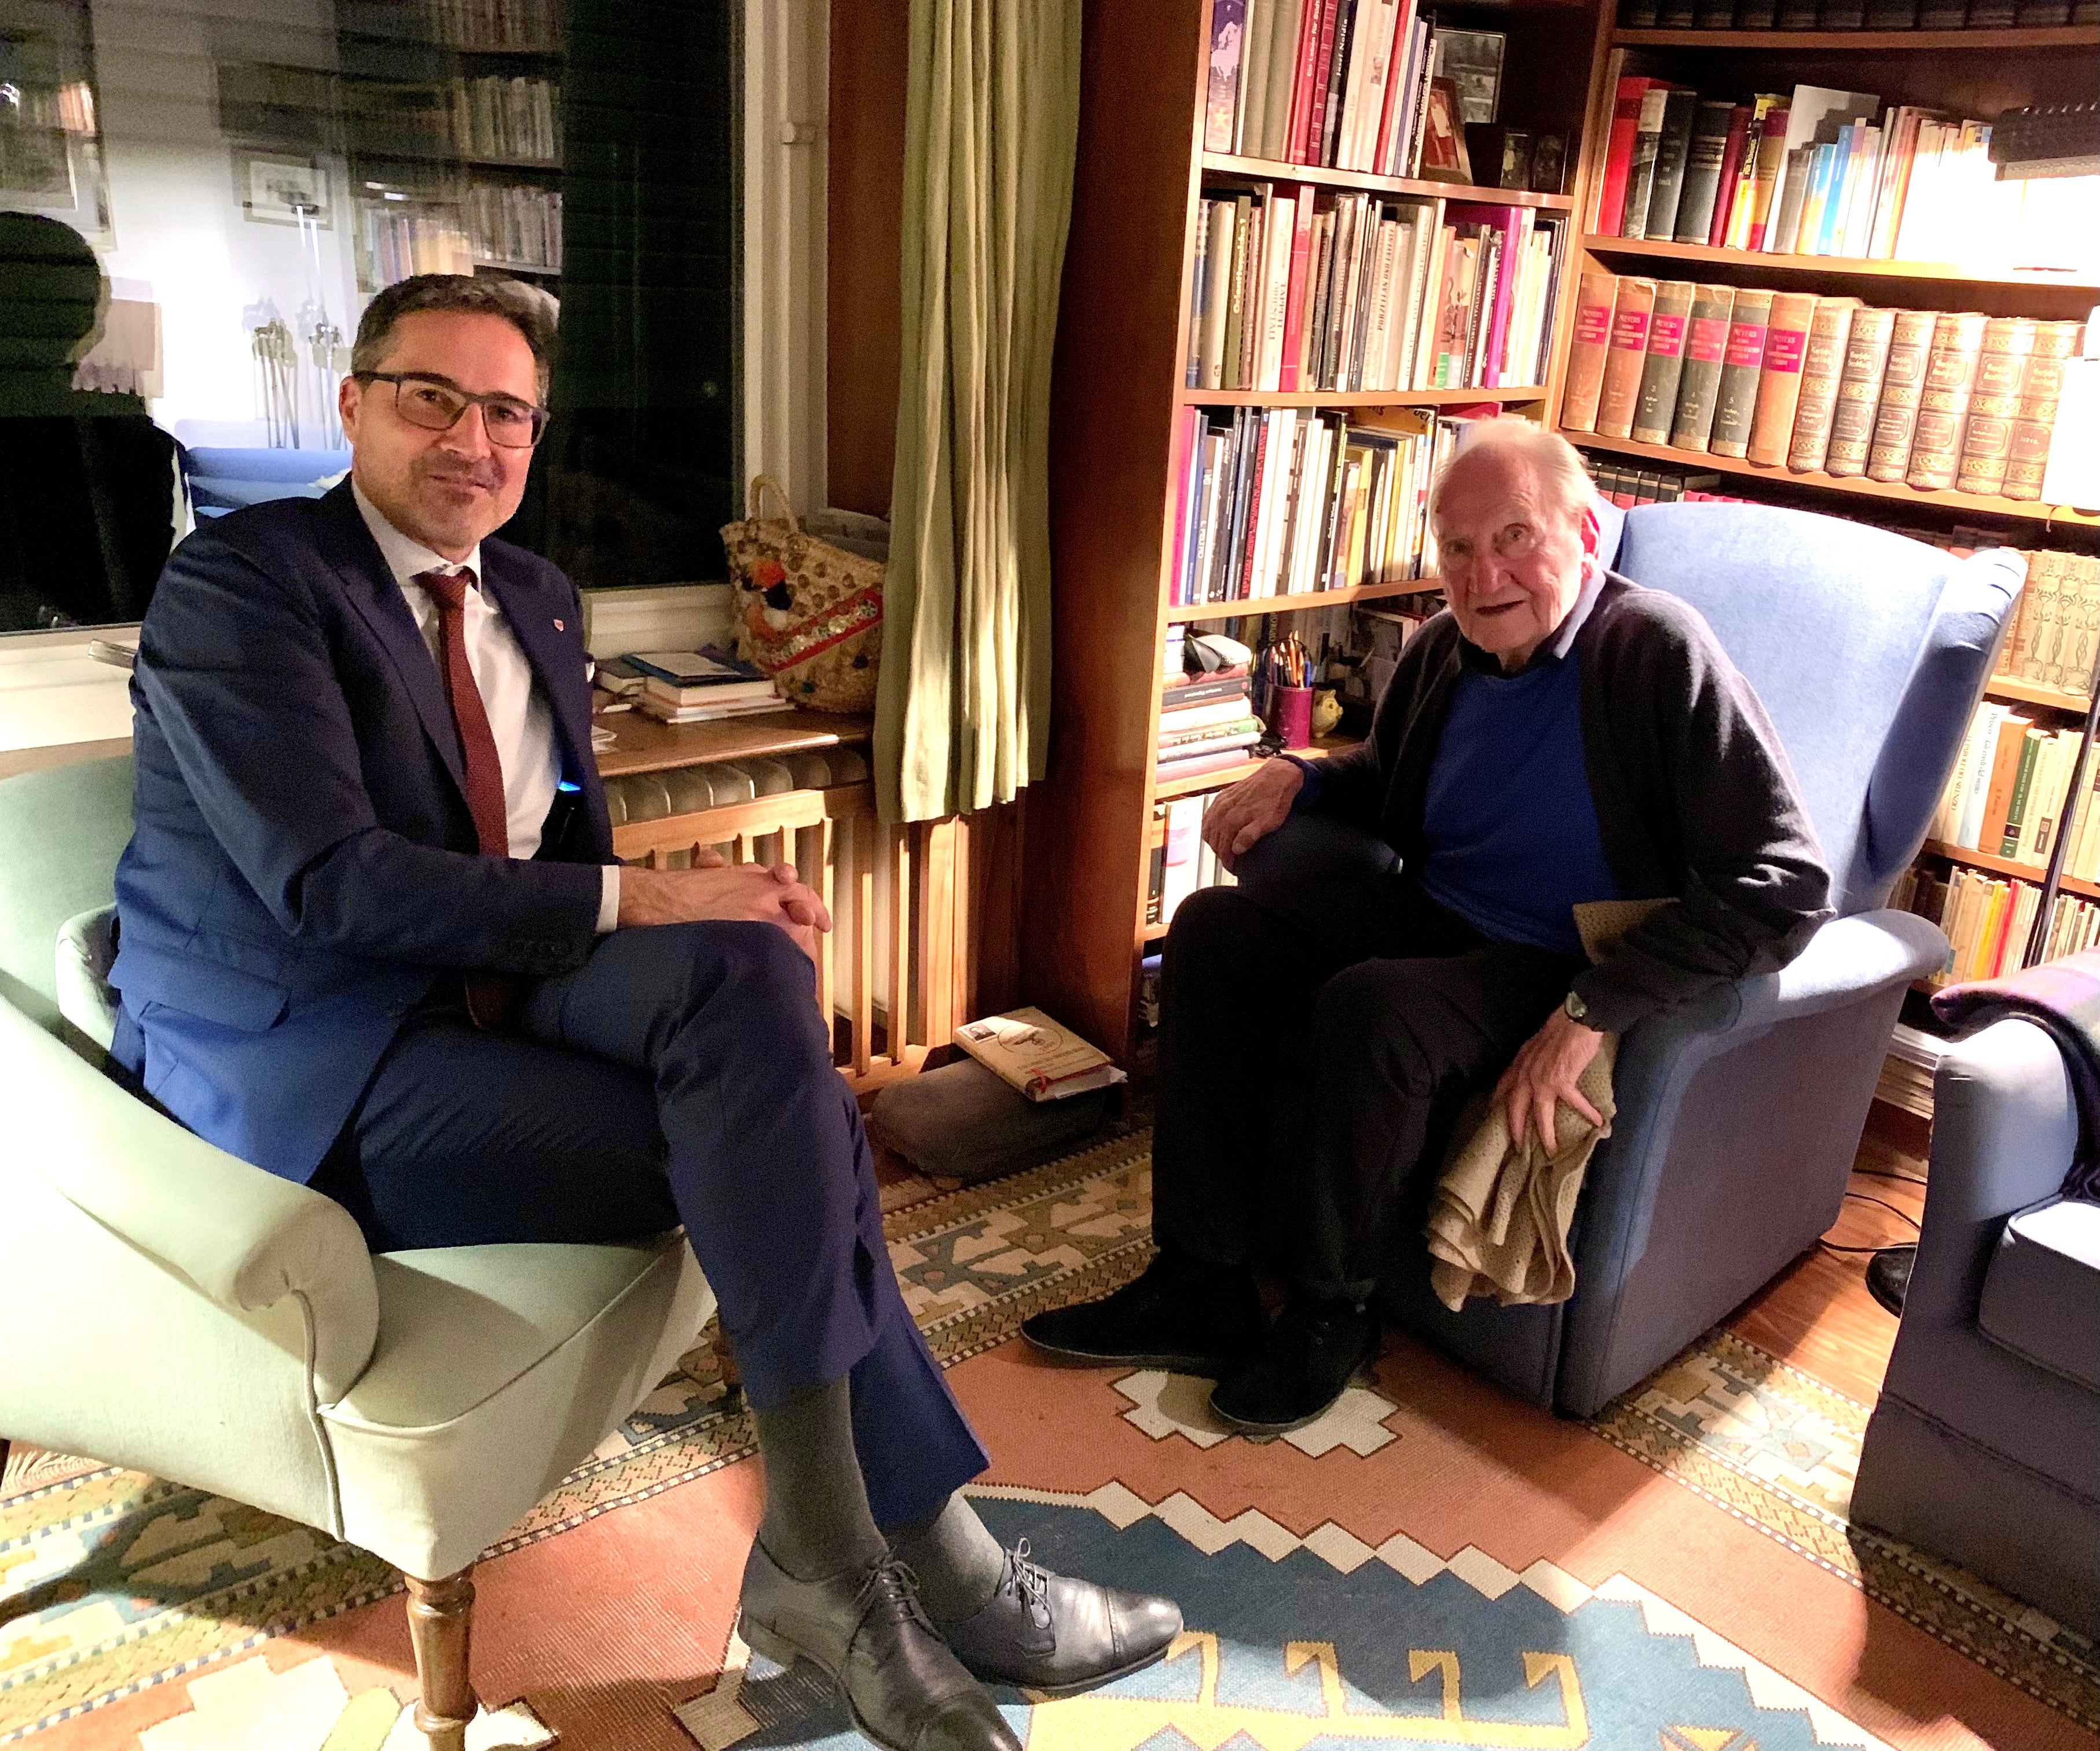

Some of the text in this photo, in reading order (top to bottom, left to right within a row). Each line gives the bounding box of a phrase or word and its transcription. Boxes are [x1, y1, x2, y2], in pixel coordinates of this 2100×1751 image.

[1339, 19, 1348, 50] Noldin
[1233, 226, 1247, 314] Orientteppiche
[1333, 259, 1347, 332] Bauernkunst
[1377, 282, 1388, 331] PORZELLAN
[1464, 281, 1482, 383] VECCHI MOBILI ITALIANI
[1732, 328, 1757, 338] MEYERS
[1197, 529, 1207, 559] PELTRO
[1987, 713, 1997, 734] Prisco
[1983, 739, 1991, 749] Gli
[1951, 781, 1961, 810] SILENZIO
[1974, 777, 1982, 793] vento
